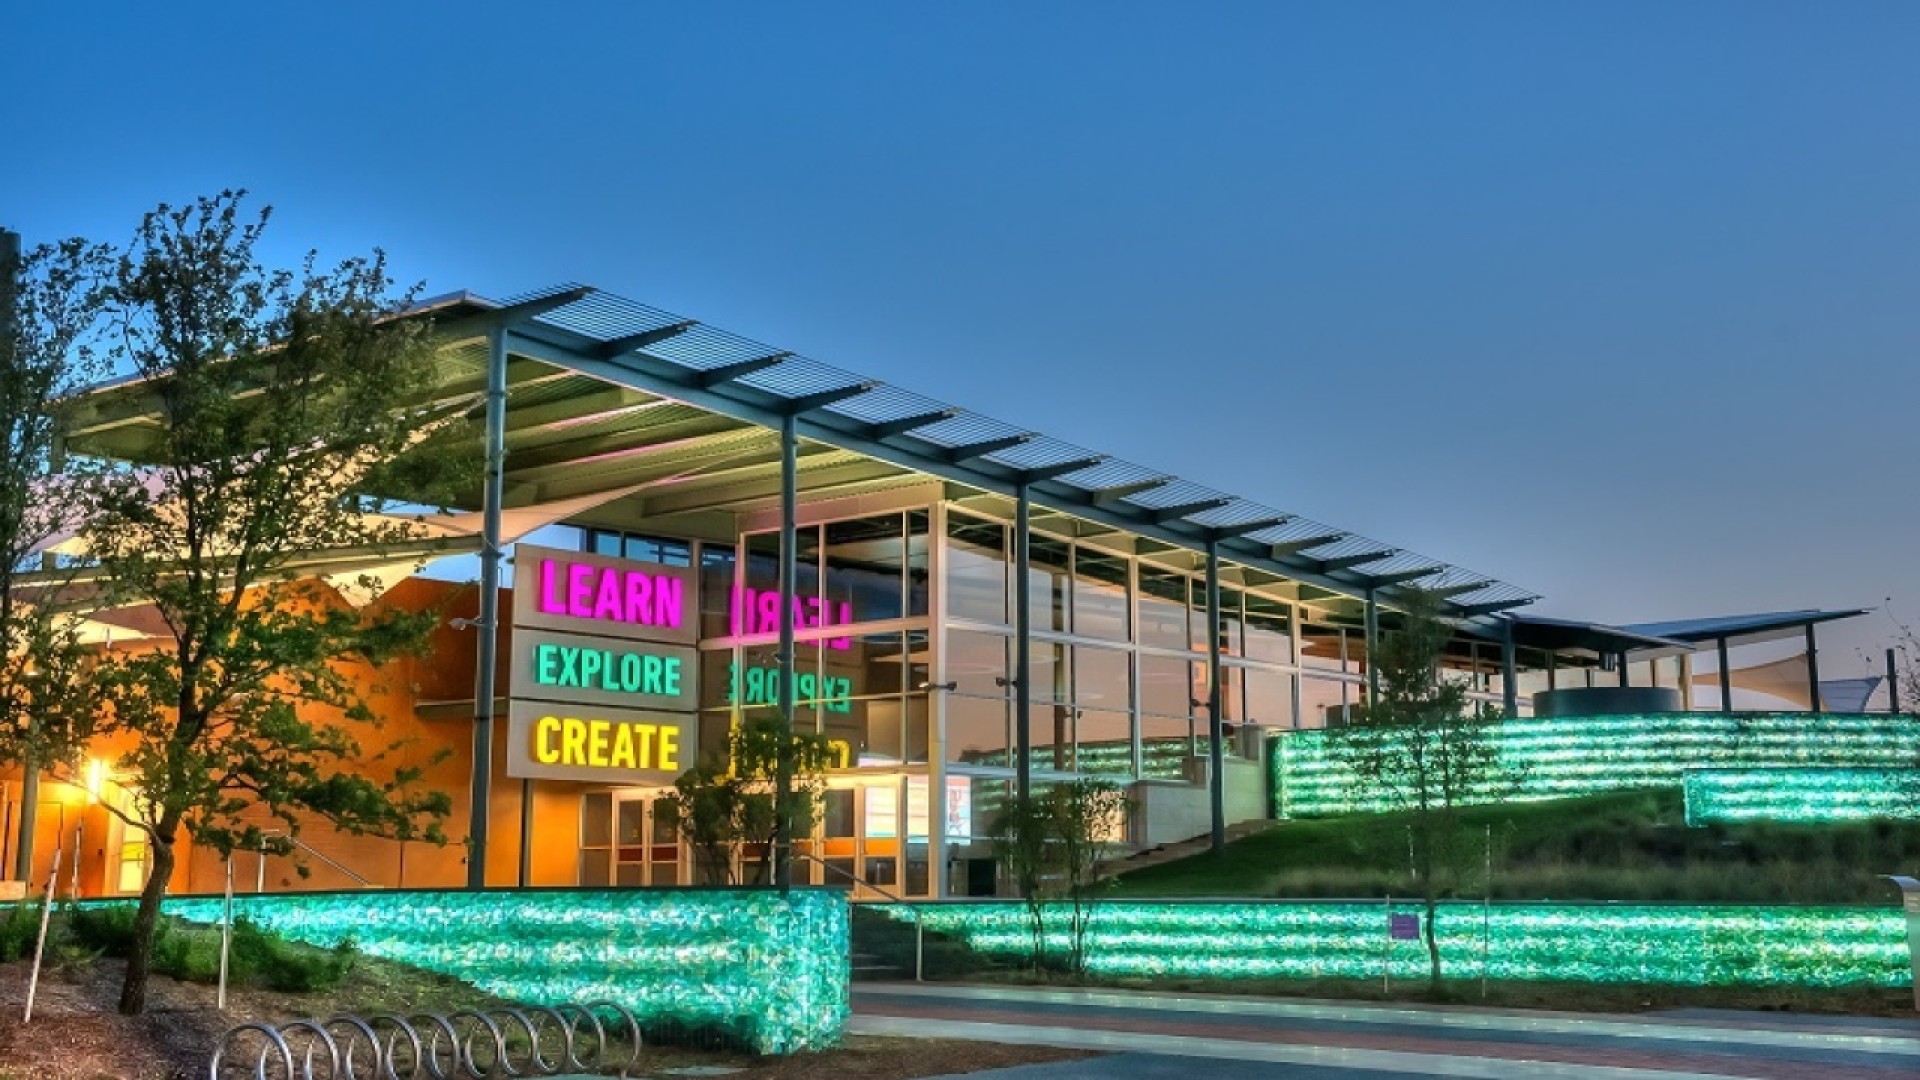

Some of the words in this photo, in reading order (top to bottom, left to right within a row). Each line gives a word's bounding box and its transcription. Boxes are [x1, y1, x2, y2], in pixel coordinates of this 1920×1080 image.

[540, 559, 683, 628] LEARN
[537, 645, 680, 695] EXPLORE
[535, 716, 679, 771] CREATE
